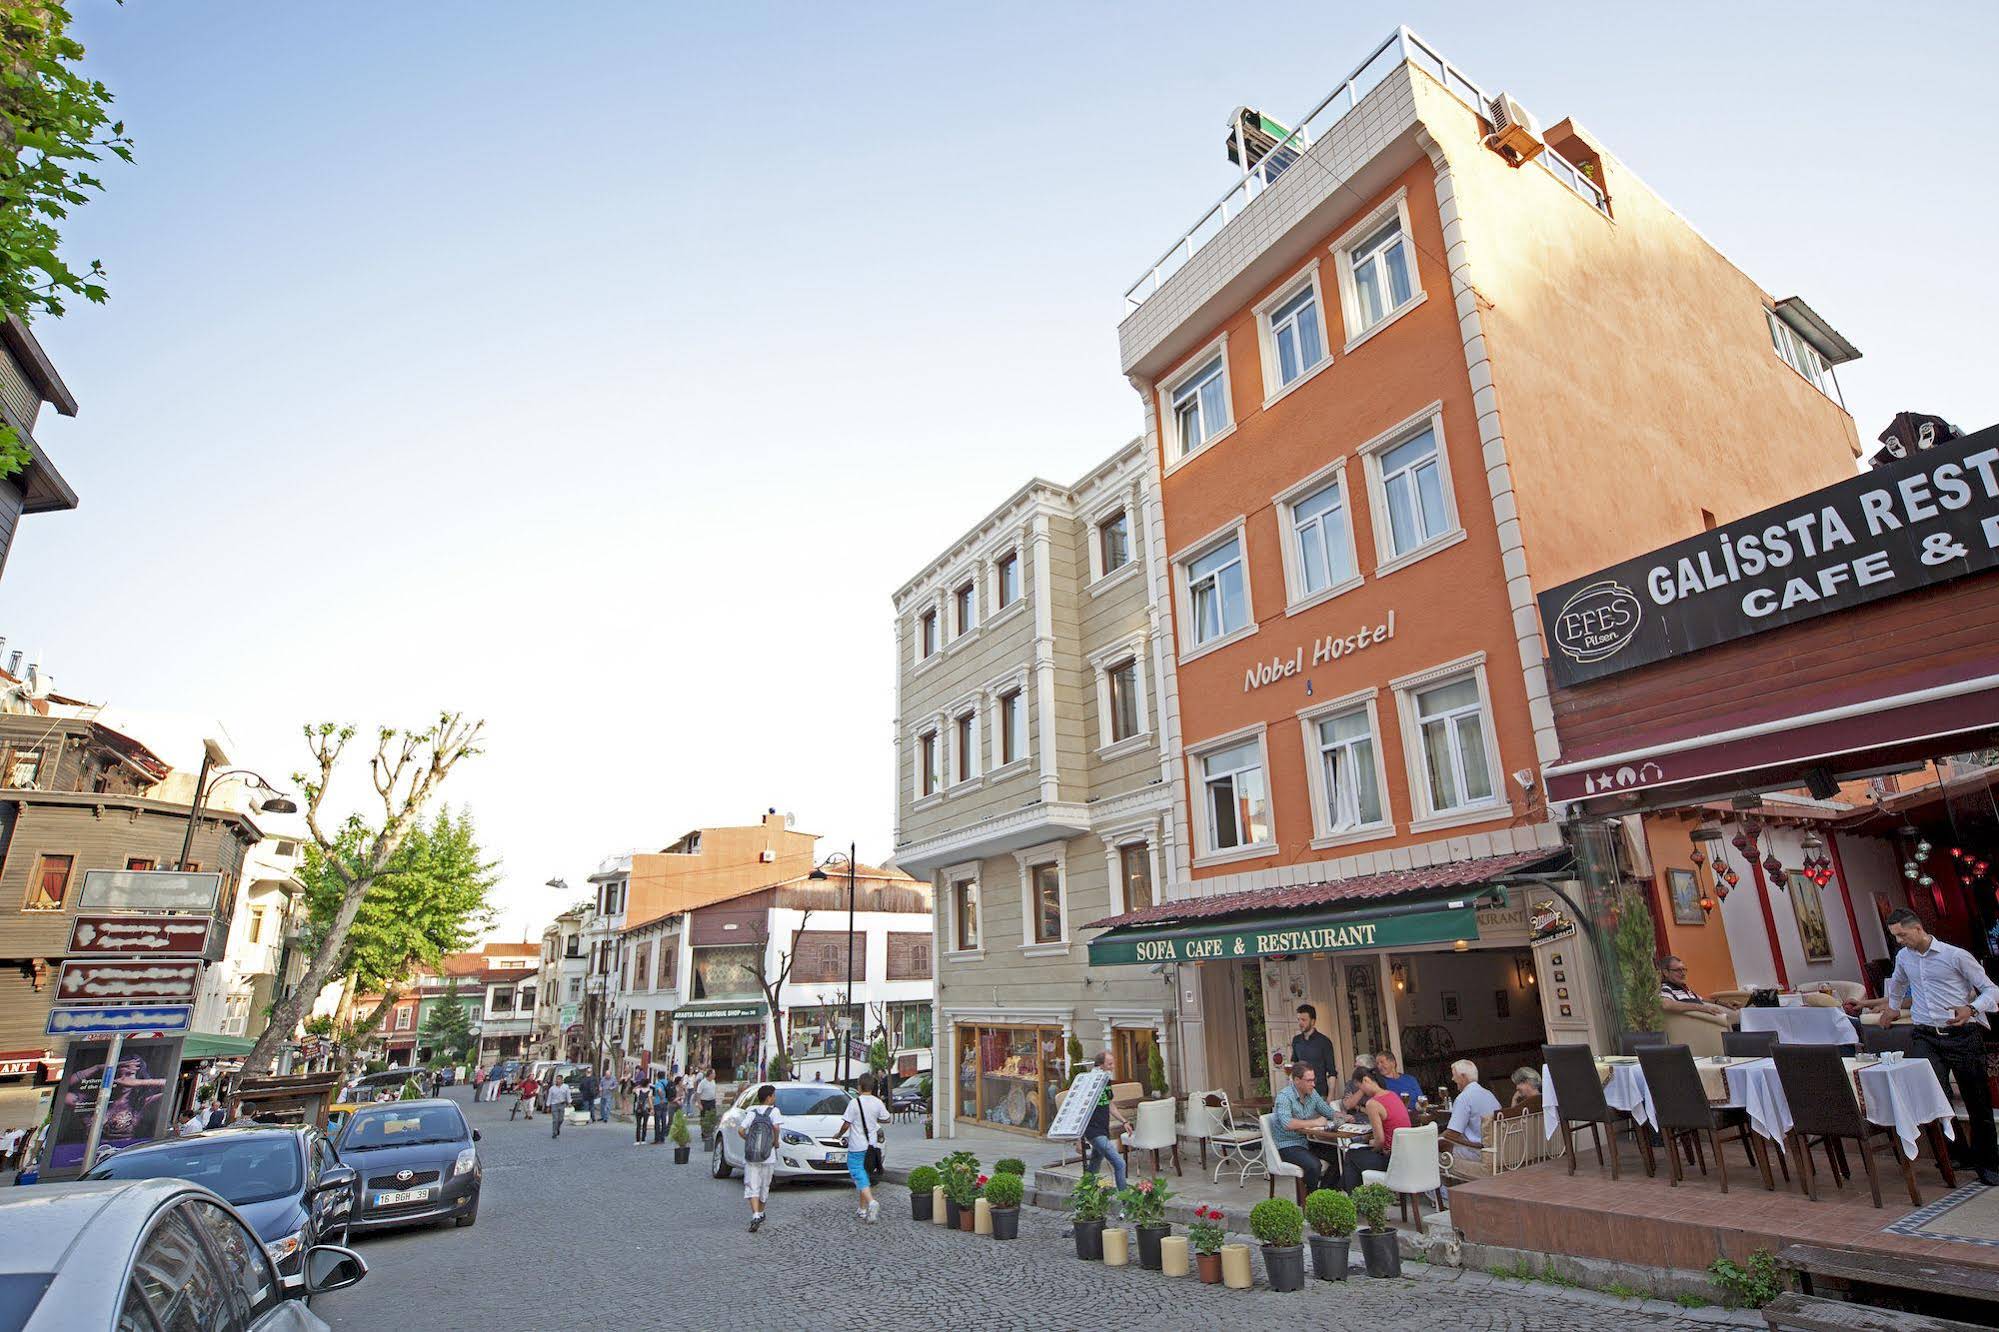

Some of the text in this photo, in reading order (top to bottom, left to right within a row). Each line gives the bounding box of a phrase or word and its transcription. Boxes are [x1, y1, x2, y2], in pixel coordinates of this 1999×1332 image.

[1741, 532, 1969, 618] CAFE &
[1562, 599, 1631, 641] EFES
[1244, 609, 1395, 693] Nobel Hostel
[1136, 924, 1377, 961] SOFA CAFE & RESTAURANT
[381, 1194, 390, 1203] 16
